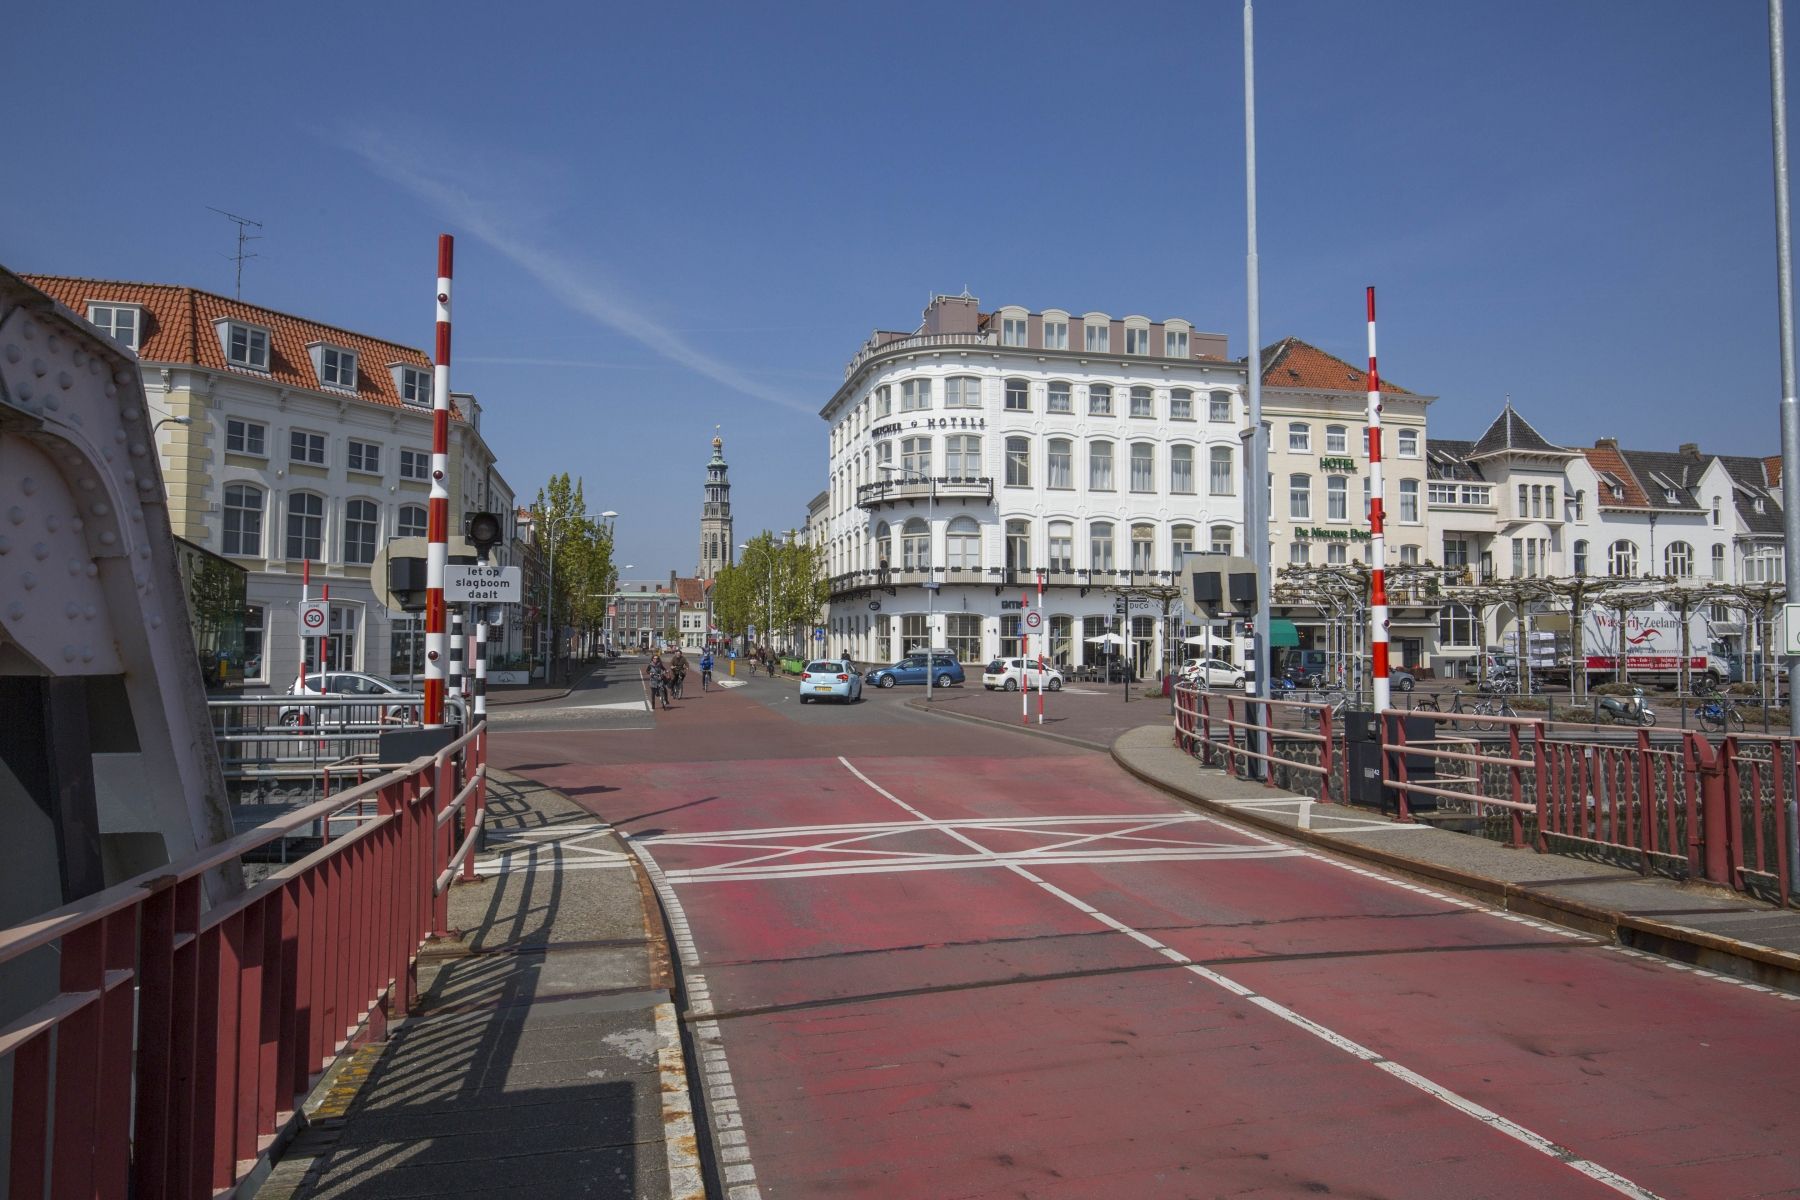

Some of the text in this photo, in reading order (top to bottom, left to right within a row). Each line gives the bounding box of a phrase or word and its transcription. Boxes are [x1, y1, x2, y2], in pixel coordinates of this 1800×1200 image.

[927, 417, 985, 428] HOTELS
[1319, 457, 1358, 470] HOTEL
[1294, 526, 1372, 539] De Nieuwe Doel
[467, 567, 500, 577] let op
[455, 577, 510, 589] slagboom
[468, 590, 499, 599] daalt
[307, 614, 321, 623] 30
